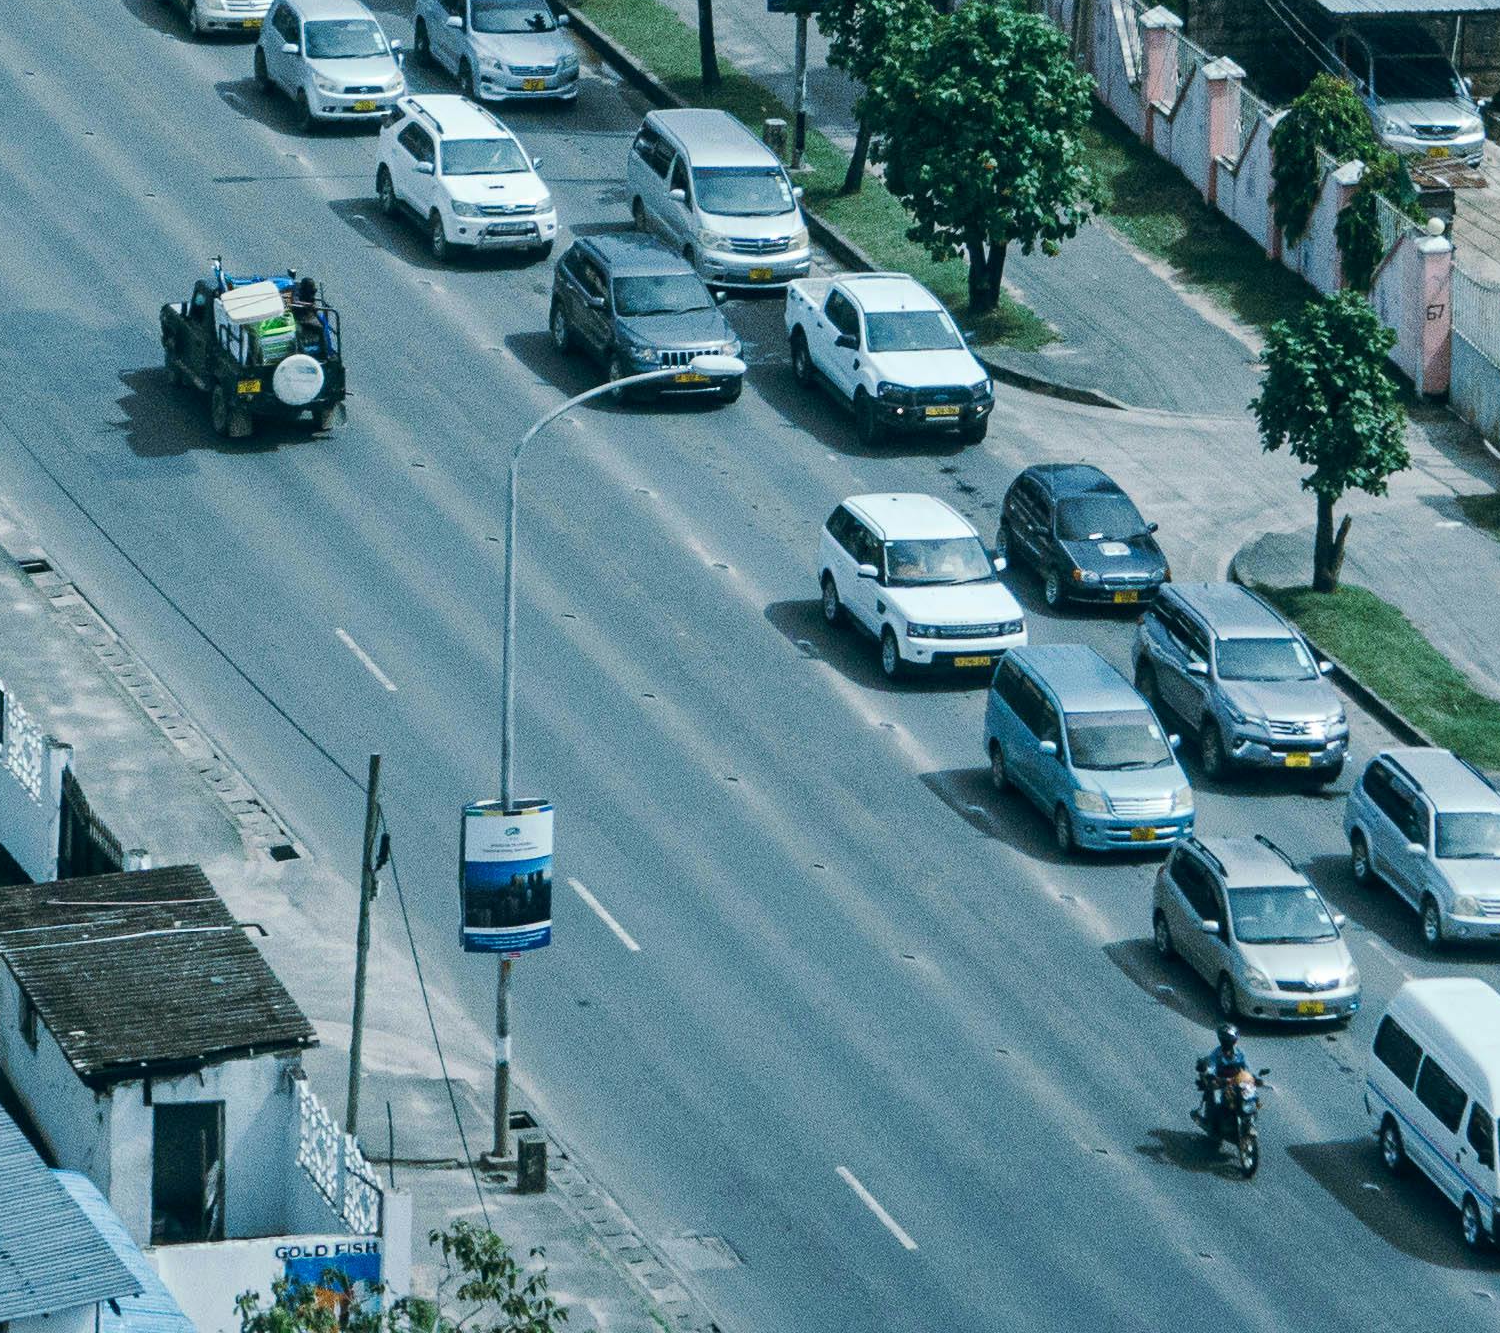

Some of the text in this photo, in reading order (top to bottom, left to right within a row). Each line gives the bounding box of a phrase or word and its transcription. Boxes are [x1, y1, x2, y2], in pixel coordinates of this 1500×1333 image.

[1426, 303, 1445, 321] 67
[275, 1242, 379, 1259] GOLD FISH
